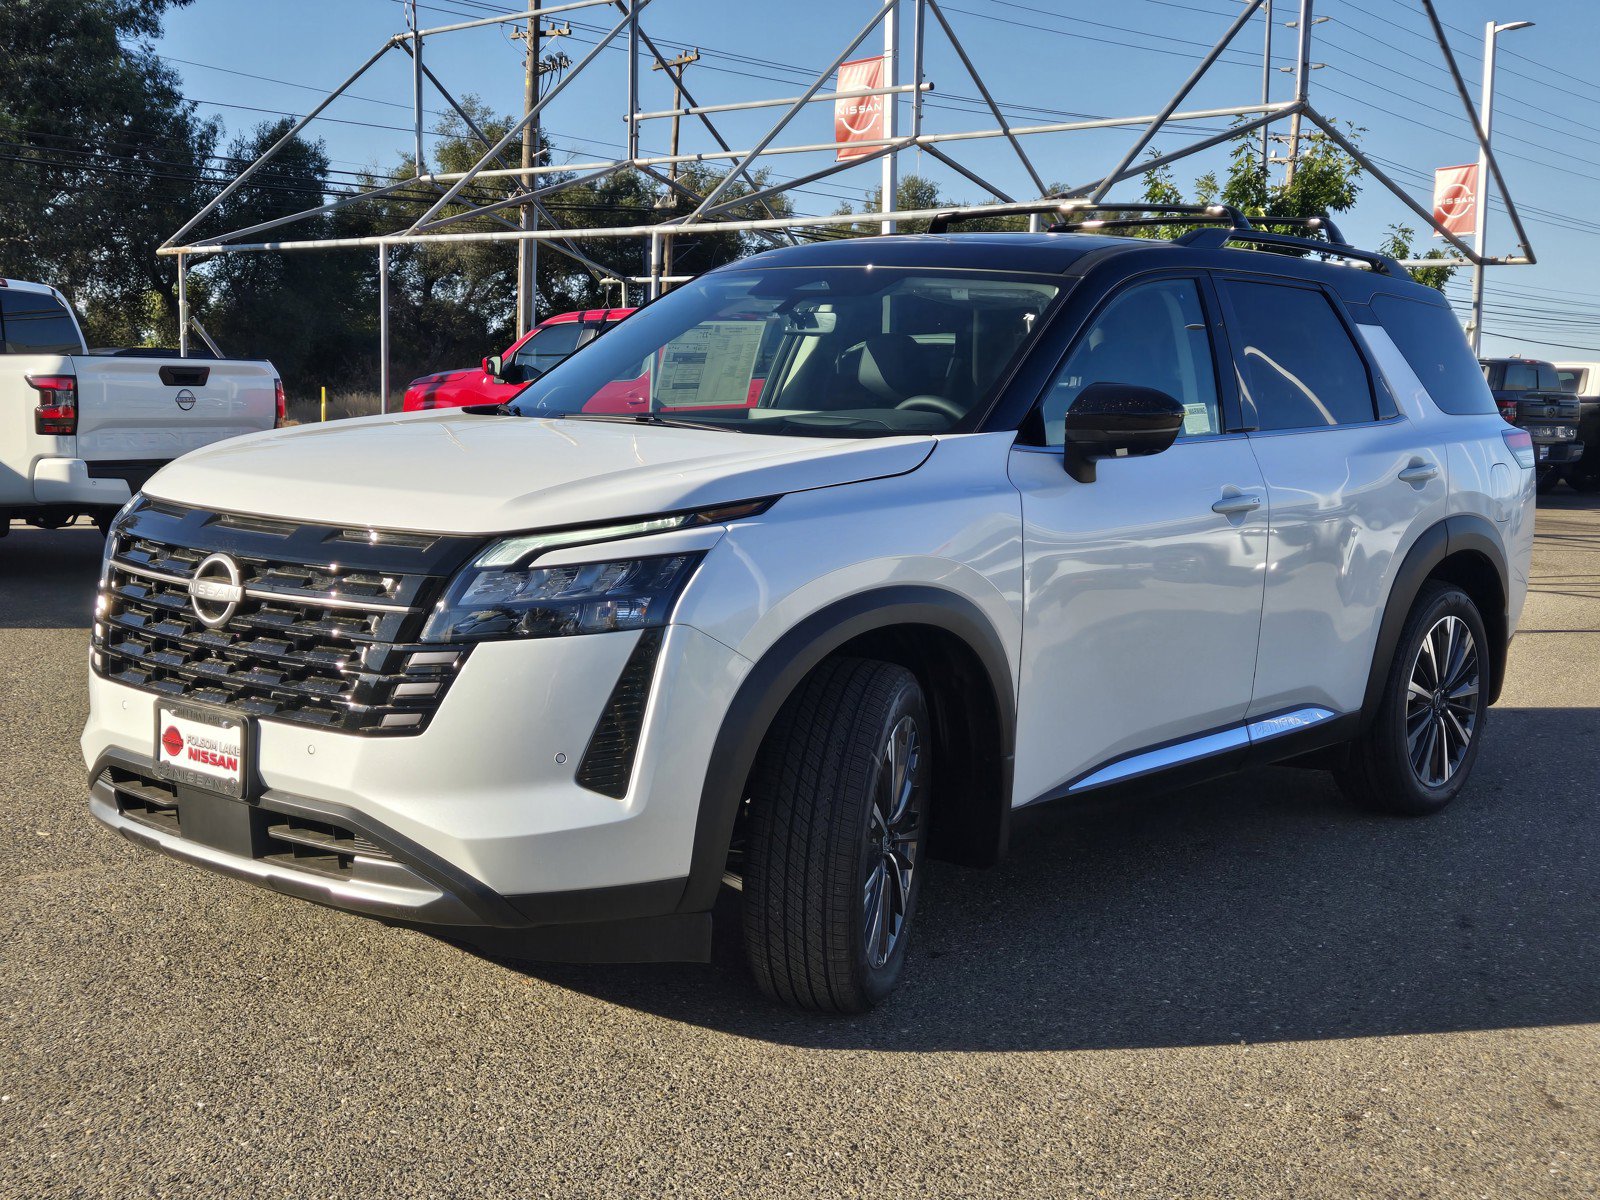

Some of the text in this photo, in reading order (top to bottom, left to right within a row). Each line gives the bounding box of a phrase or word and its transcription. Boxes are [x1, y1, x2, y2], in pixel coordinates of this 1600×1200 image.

[837, 103, 882, 115] NISSAN
[189, 582, 239, 601] NISSAN
[186, 734, 240, 757] FOLSOM LAKE
[188, 747, 237, 771] NISSAN
[173, 769, 222, 790] NISSAN
